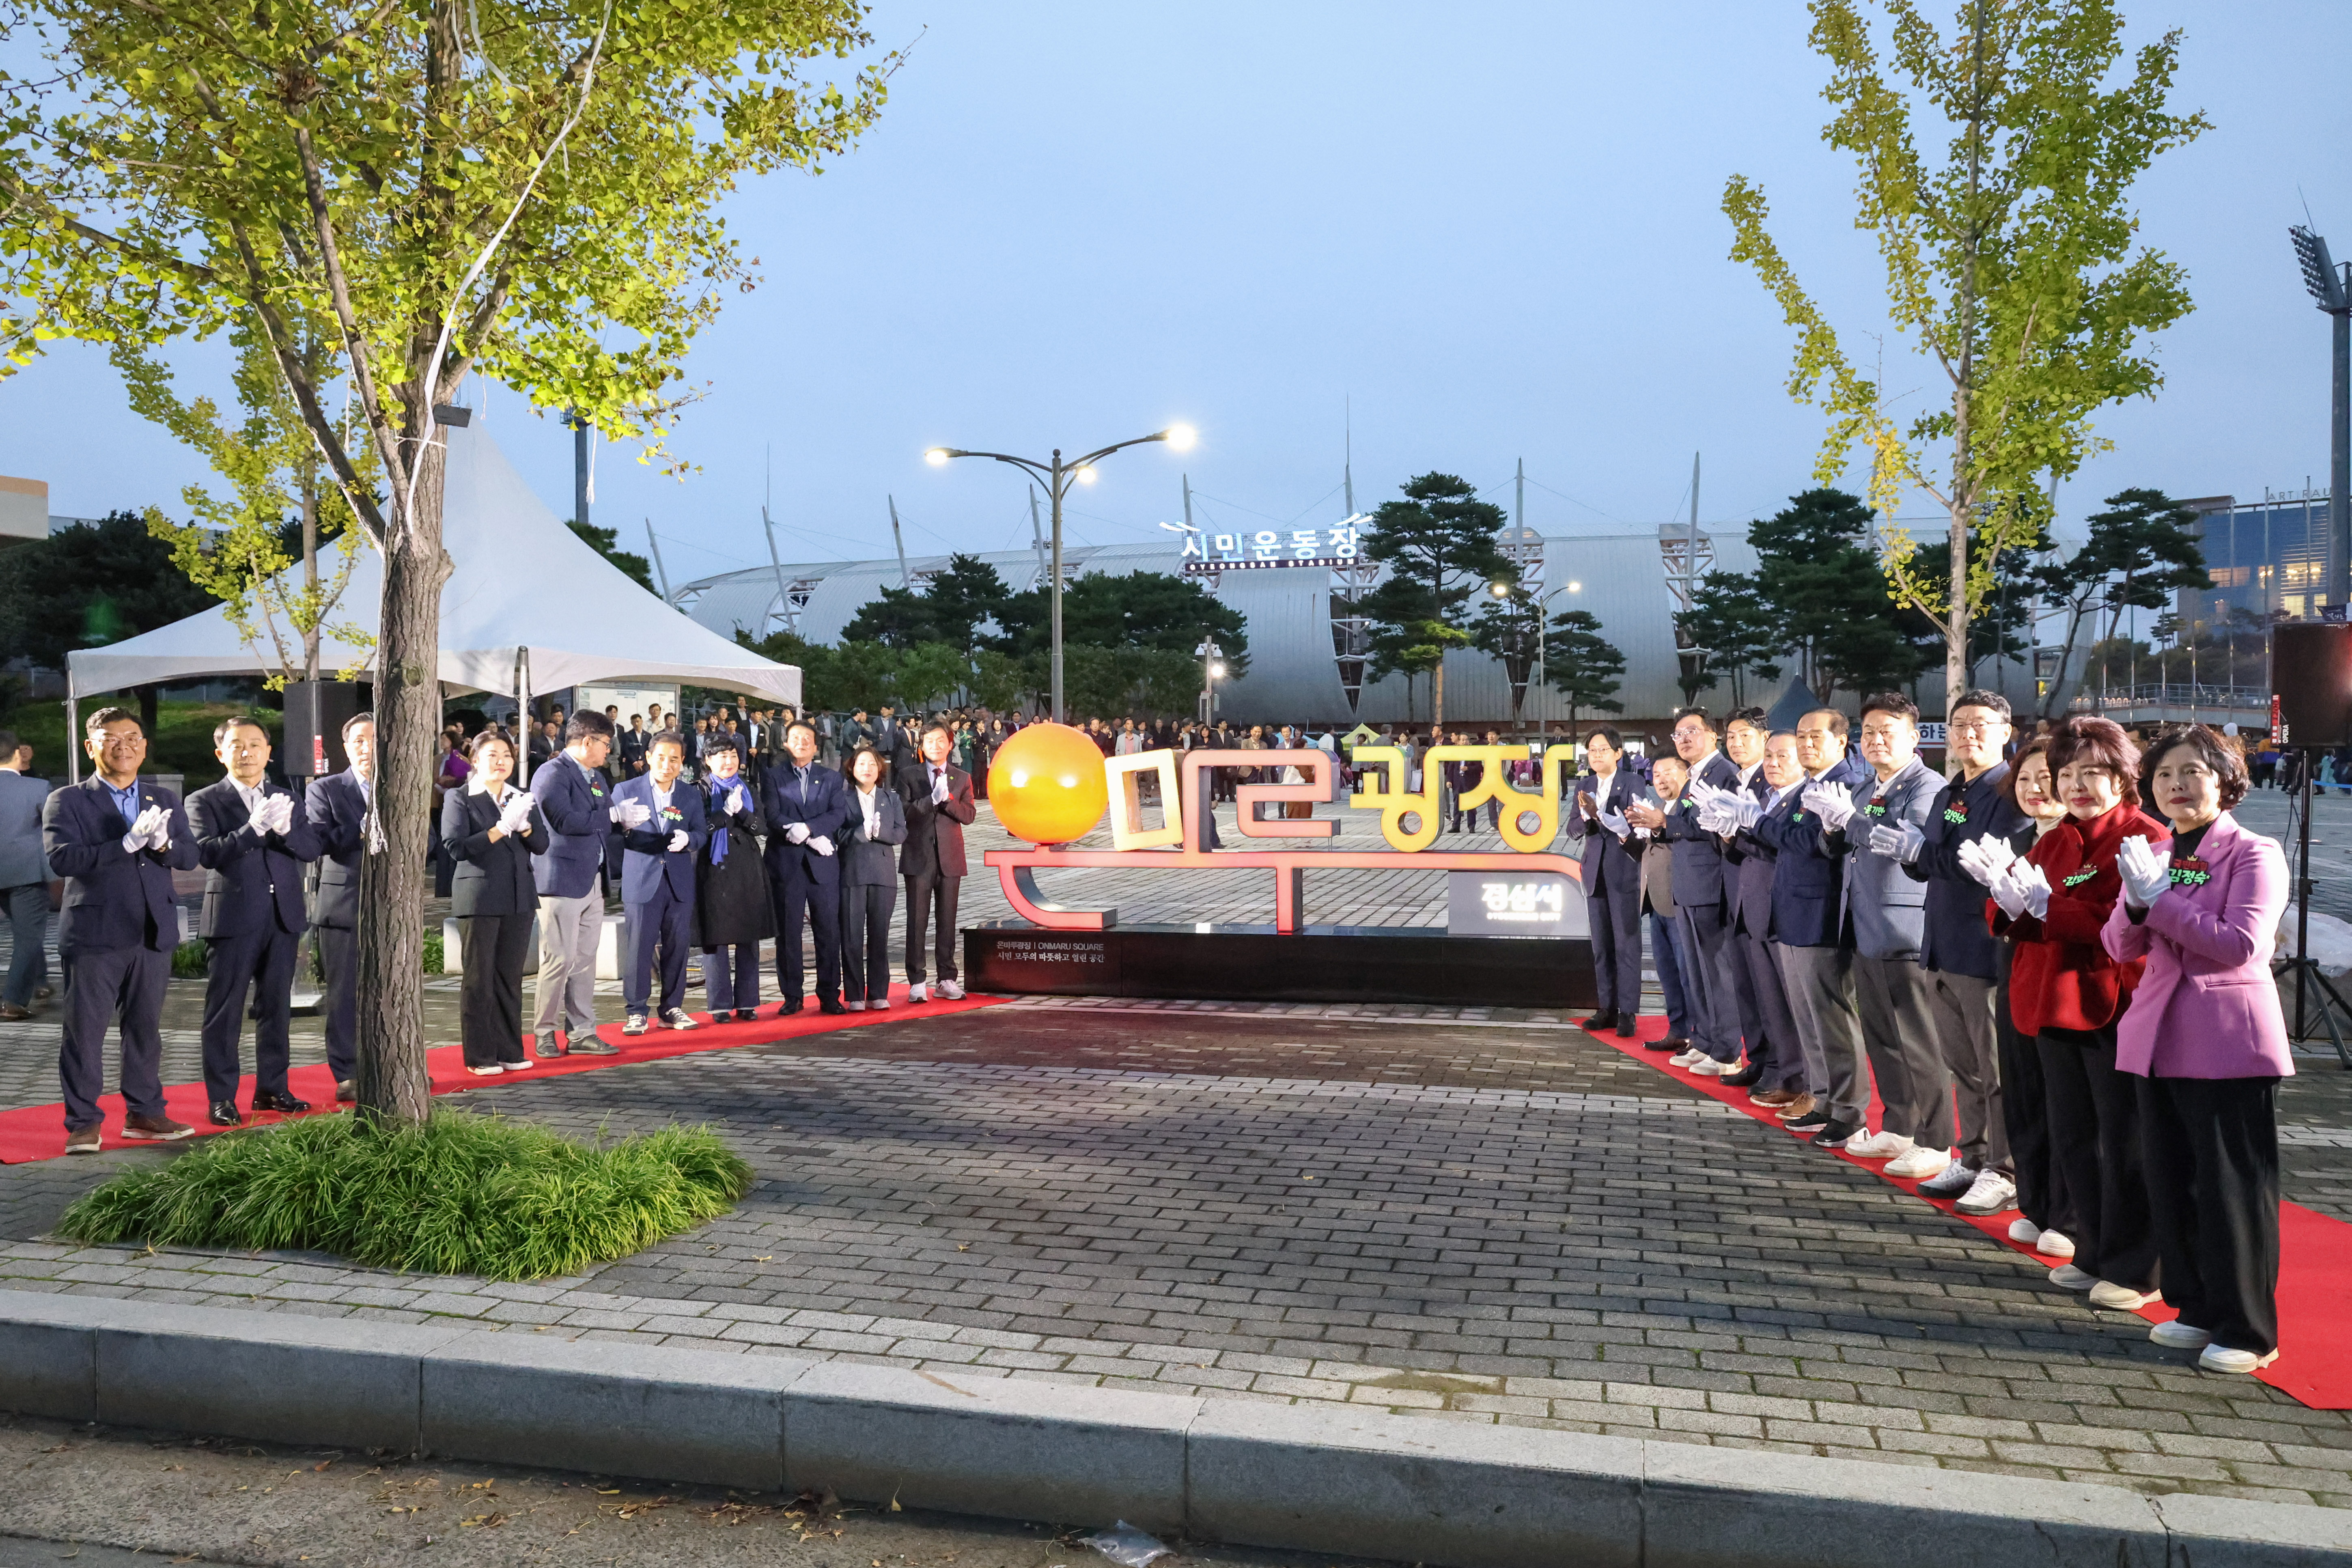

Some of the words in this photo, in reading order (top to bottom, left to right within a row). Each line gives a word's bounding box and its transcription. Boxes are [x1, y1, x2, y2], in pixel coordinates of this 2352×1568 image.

[1181, 527, 1361, 562] 시민운동장
[1189, 561, 1276, 571] GYEONGSAN
[1288, 558, 1355, 568] STADIUM
[1944, 809, 1964, 824] 김인수
[2168, 868, 2207, 885] 김정숙
[997, 941, 1031, 950] 온마루광장
[1073, 943, 1104, 951] SQUARE
[998, 951, 1012, 961] 시민
[1014, 952, 1037, 961] 모두의
[1038, 952, 1070, 962] 따뜻하고
[1072, 954, 1087, 962] 열린
[1089, 954, 1105, 963] 공간
